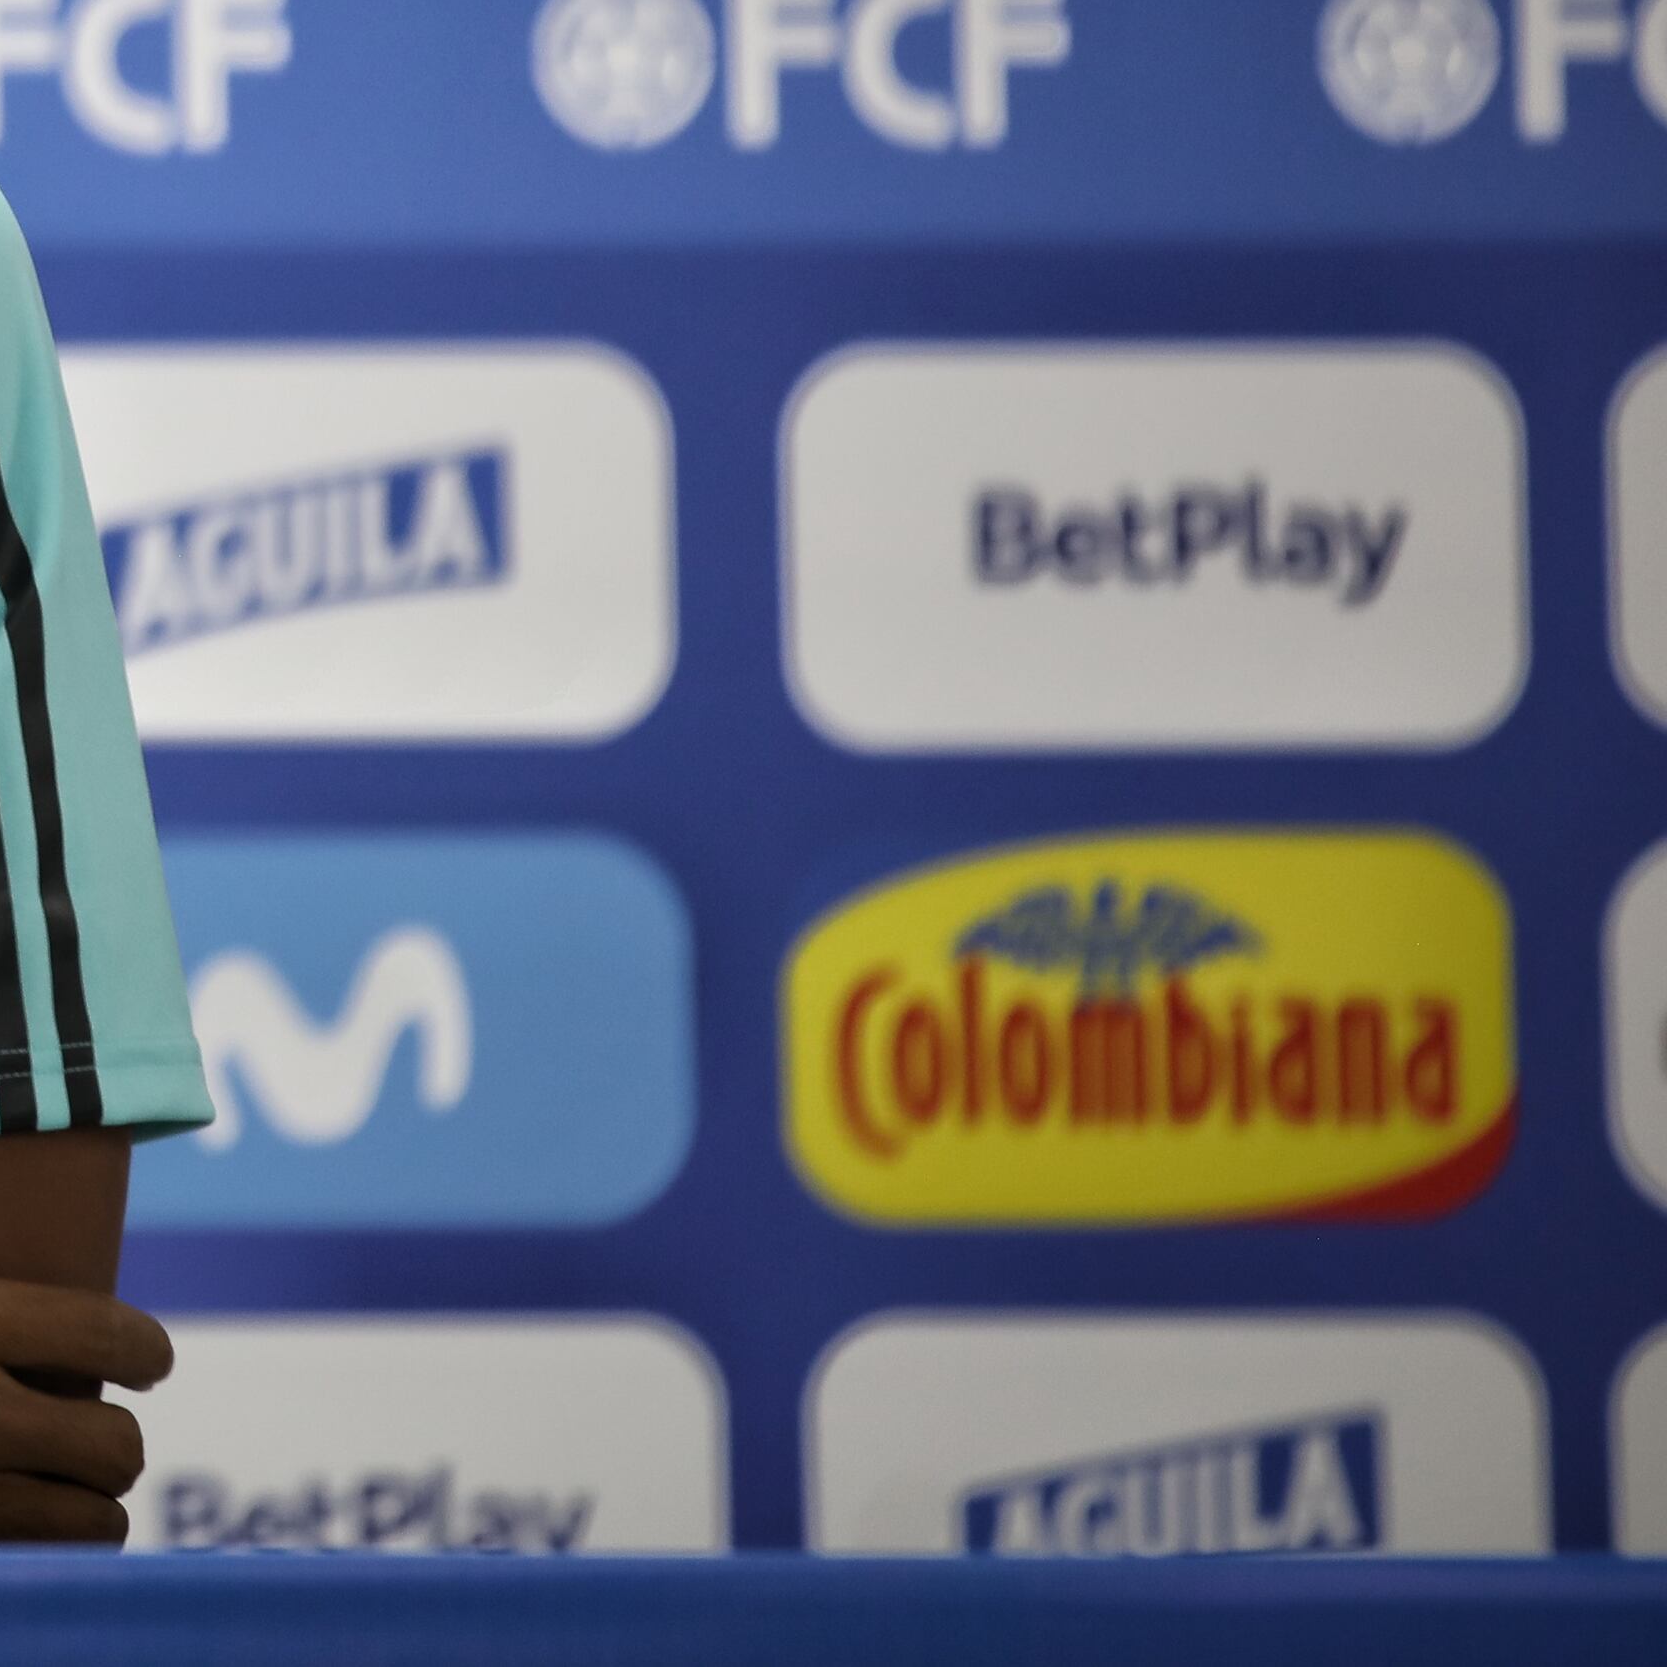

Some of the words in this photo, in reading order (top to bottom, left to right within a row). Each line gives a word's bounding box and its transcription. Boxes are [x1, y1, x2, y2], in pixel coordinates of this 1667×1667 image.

[120, 456, 492, 649] AGUILA
[970, 475, 1409, 611] BetPlay
[835, 954, 1464, 1164] Colombiana
[991, 1430, 1366, 1556] AGUILA
